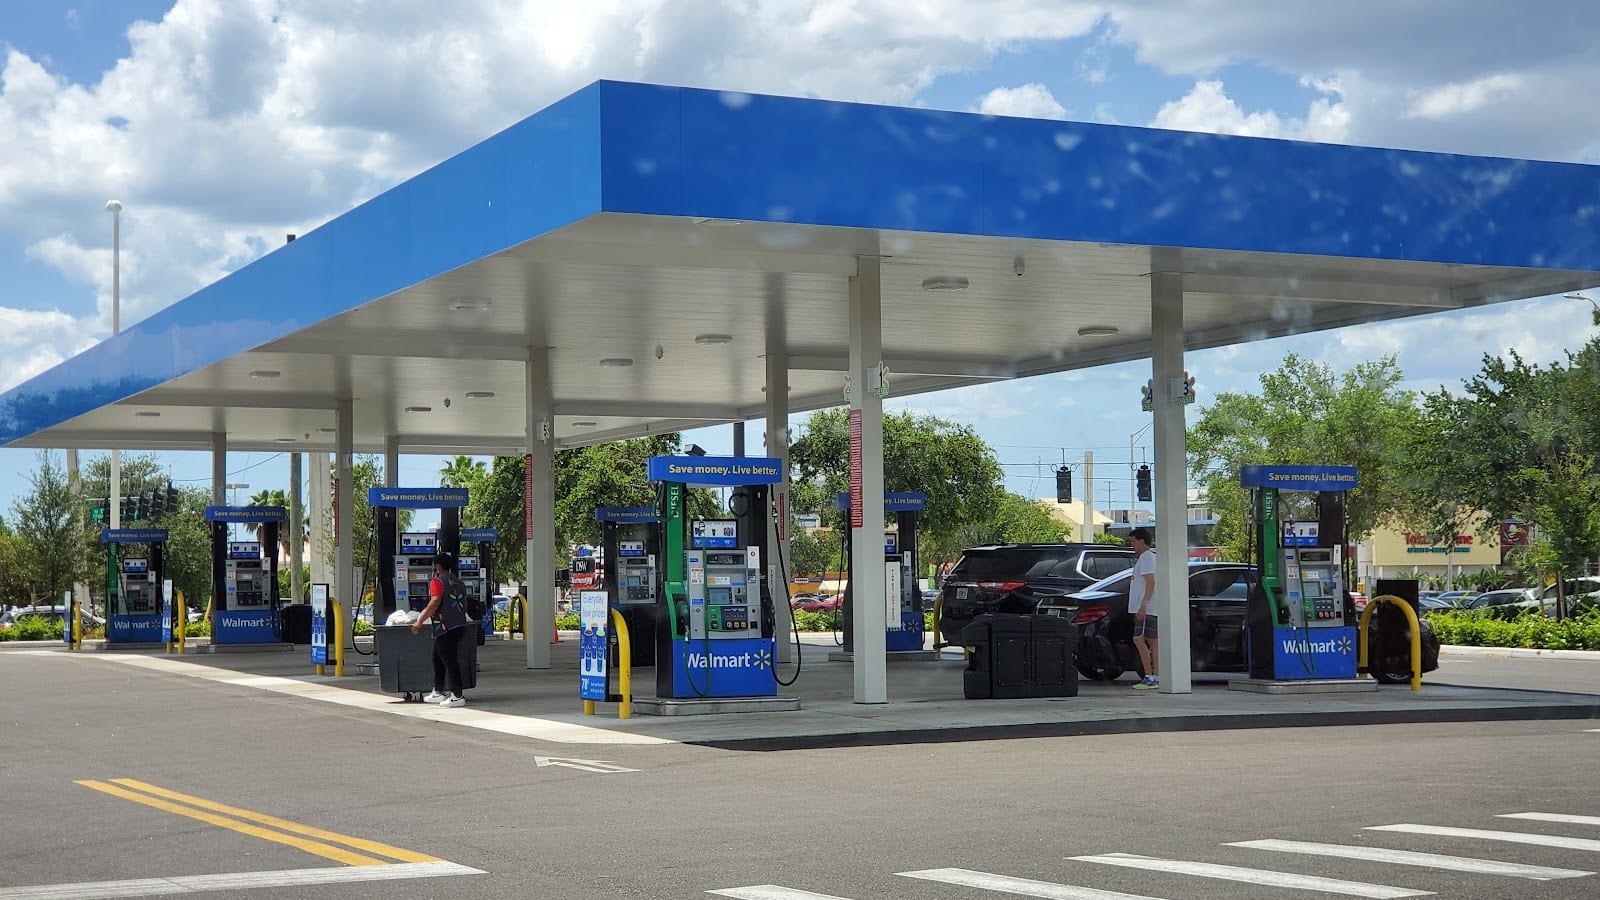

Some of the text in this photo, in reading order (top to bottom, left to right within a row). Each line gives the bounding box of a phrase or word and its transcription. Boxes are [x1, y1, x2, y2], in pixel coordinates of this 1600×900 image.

[878, 371, 883, 387] 1
[1183, 381, 1189, 395] 3
[1147, 388, 1153, 402] 4
[669, 464, 778, 476] Save money. Live better.
[1268, 472, 1355, 483] Save money. Live better.
[380, 493, 398, 501] Save
[428, 493, 444, 501] Live
[575, 560, 588, 572] DSW
[583, 593, 605, 606] Everyday
[591, 610, 606, 620] prices
[113, 621, 151, 629] Walmart
[221, 617, 265, 628] Walmart
[1282, 639, 1336, 654] Walmart
[687, 652, 751, 669] Walmart
